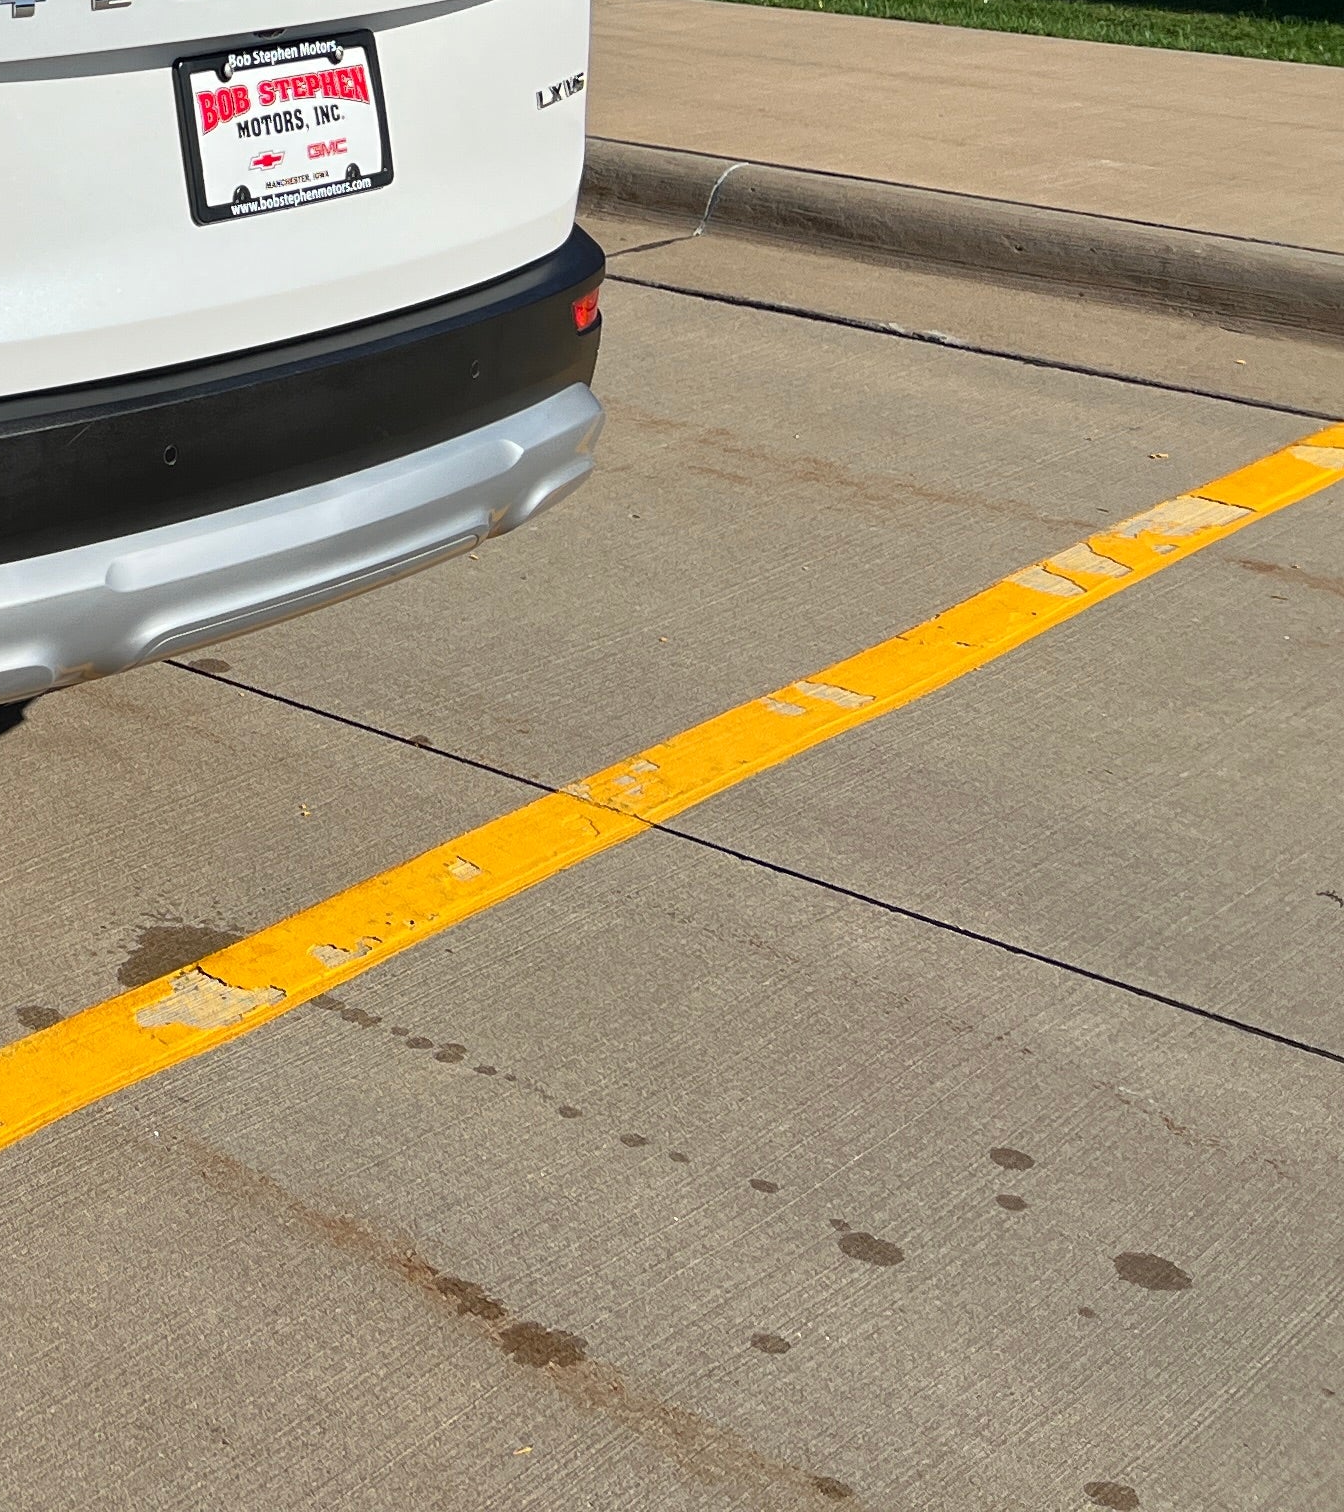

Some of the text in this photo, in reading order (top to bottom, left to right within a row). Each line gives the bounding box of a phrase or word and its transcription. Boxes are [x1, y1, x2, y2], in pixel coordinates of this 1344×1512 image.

[228, 53, 251, 69] Bob
[253, 48, 298, 65] Stephen
[195, 64, 371, 136] BOB STEPHEN
[237, 104, 345, 138] MOTORS, INC.
[306, 137, 348, 161] GMC
[230, 177, 372, 216] www.bobstephenmotors.com
